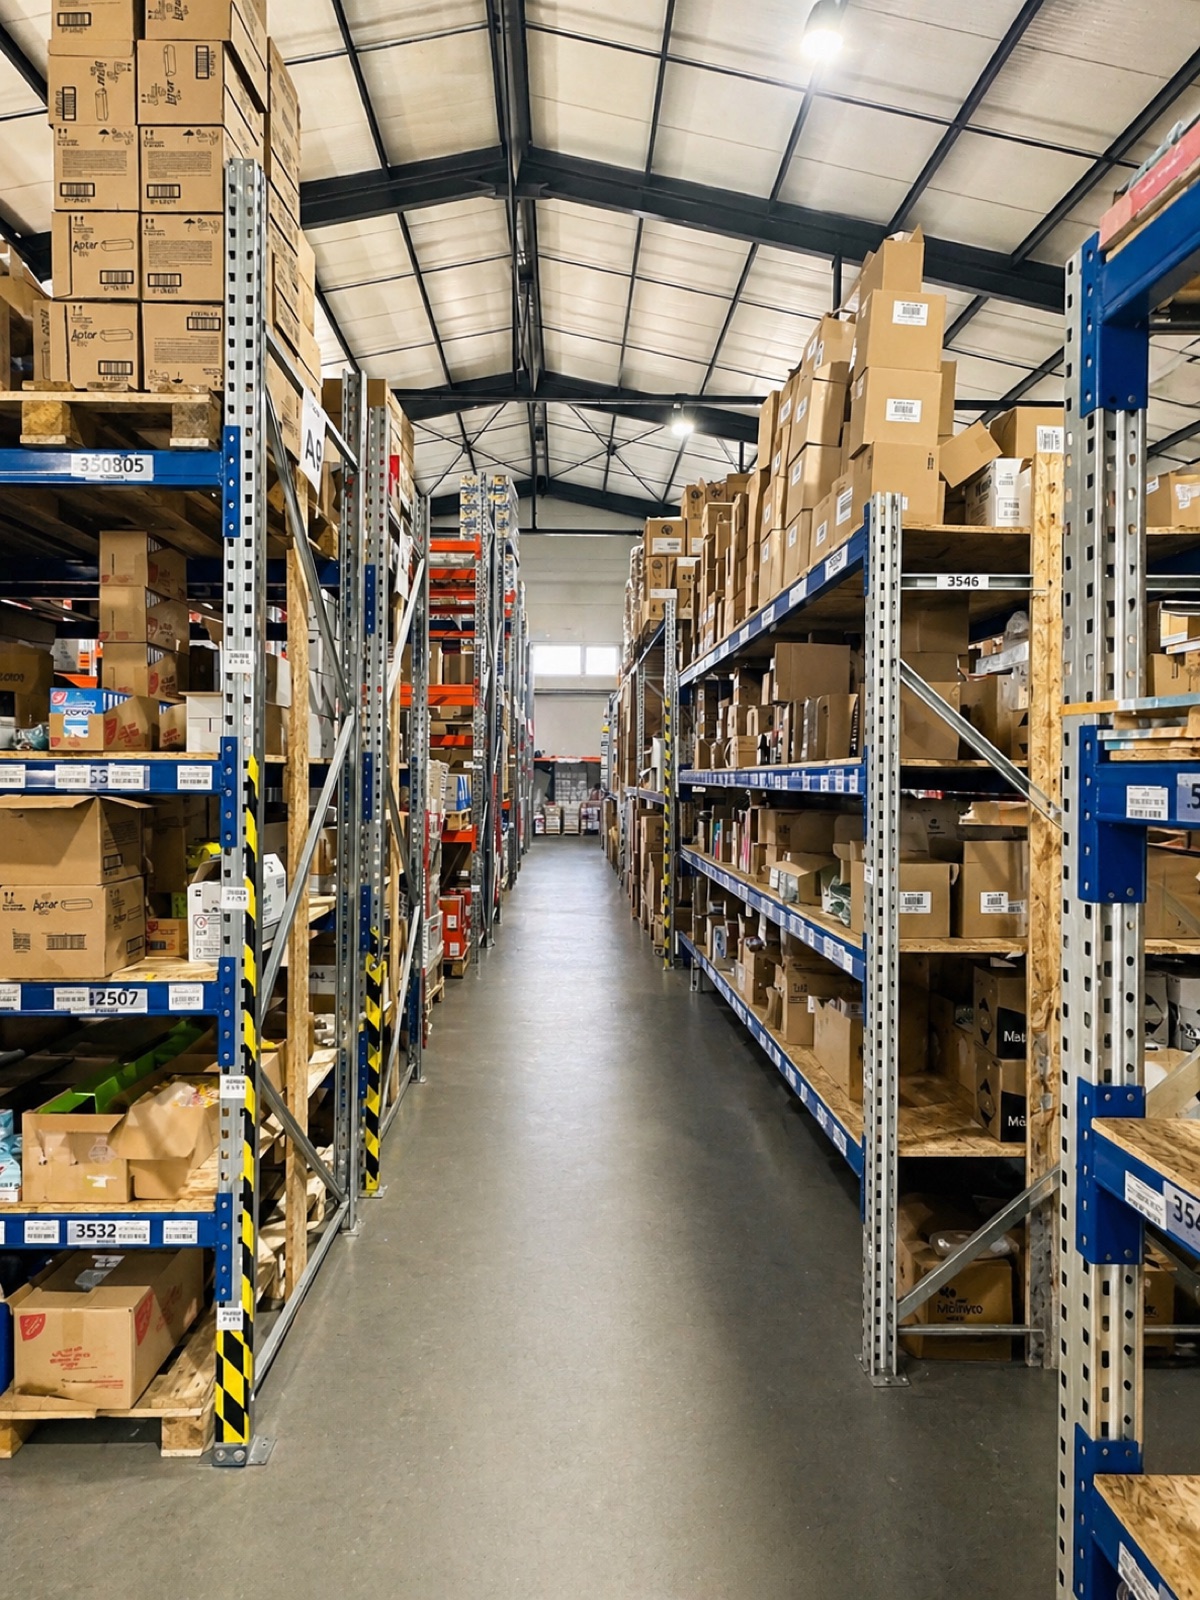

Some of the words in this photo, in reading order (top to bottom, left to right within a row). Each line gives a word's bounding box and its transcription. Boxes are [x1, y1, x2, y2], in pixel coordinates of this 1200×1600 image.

[80, 457, 144, 473] 350805
[947, 576, 979, 587] 3546
[76, 1224, 117, 1238] 3532
